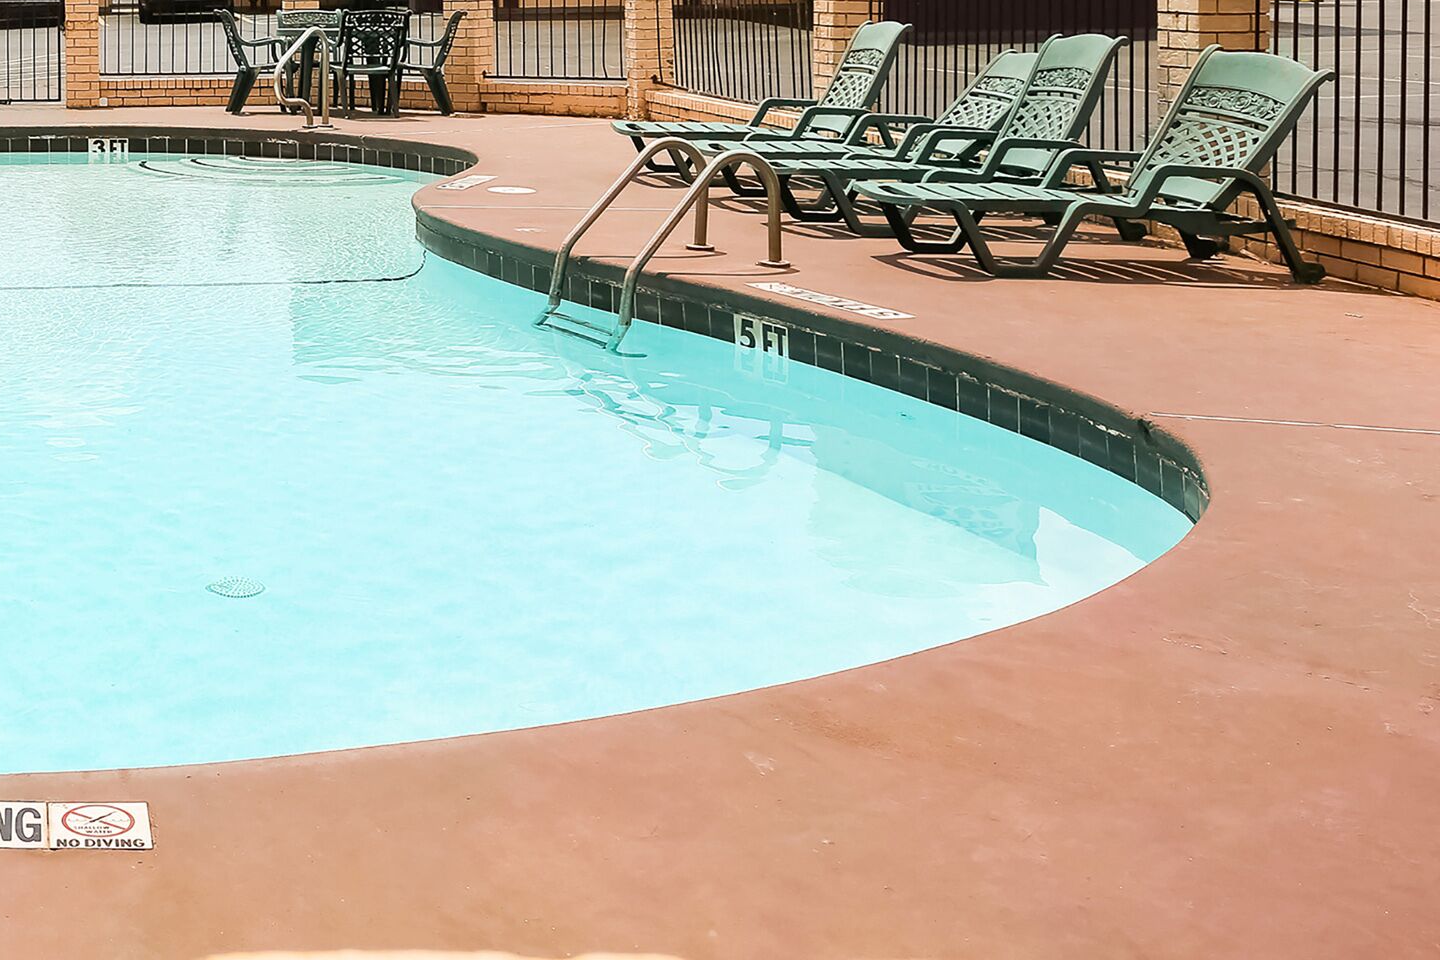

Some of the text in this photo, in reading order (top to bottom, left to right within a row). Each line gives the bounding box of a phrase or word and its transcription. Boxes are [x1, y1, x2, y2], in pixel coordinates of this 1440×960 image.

[92, 139, 127, 153] 3 FT
[740, 318, 787, 357] 5 FT
[56, 838, 145, 848] NO DIVING
